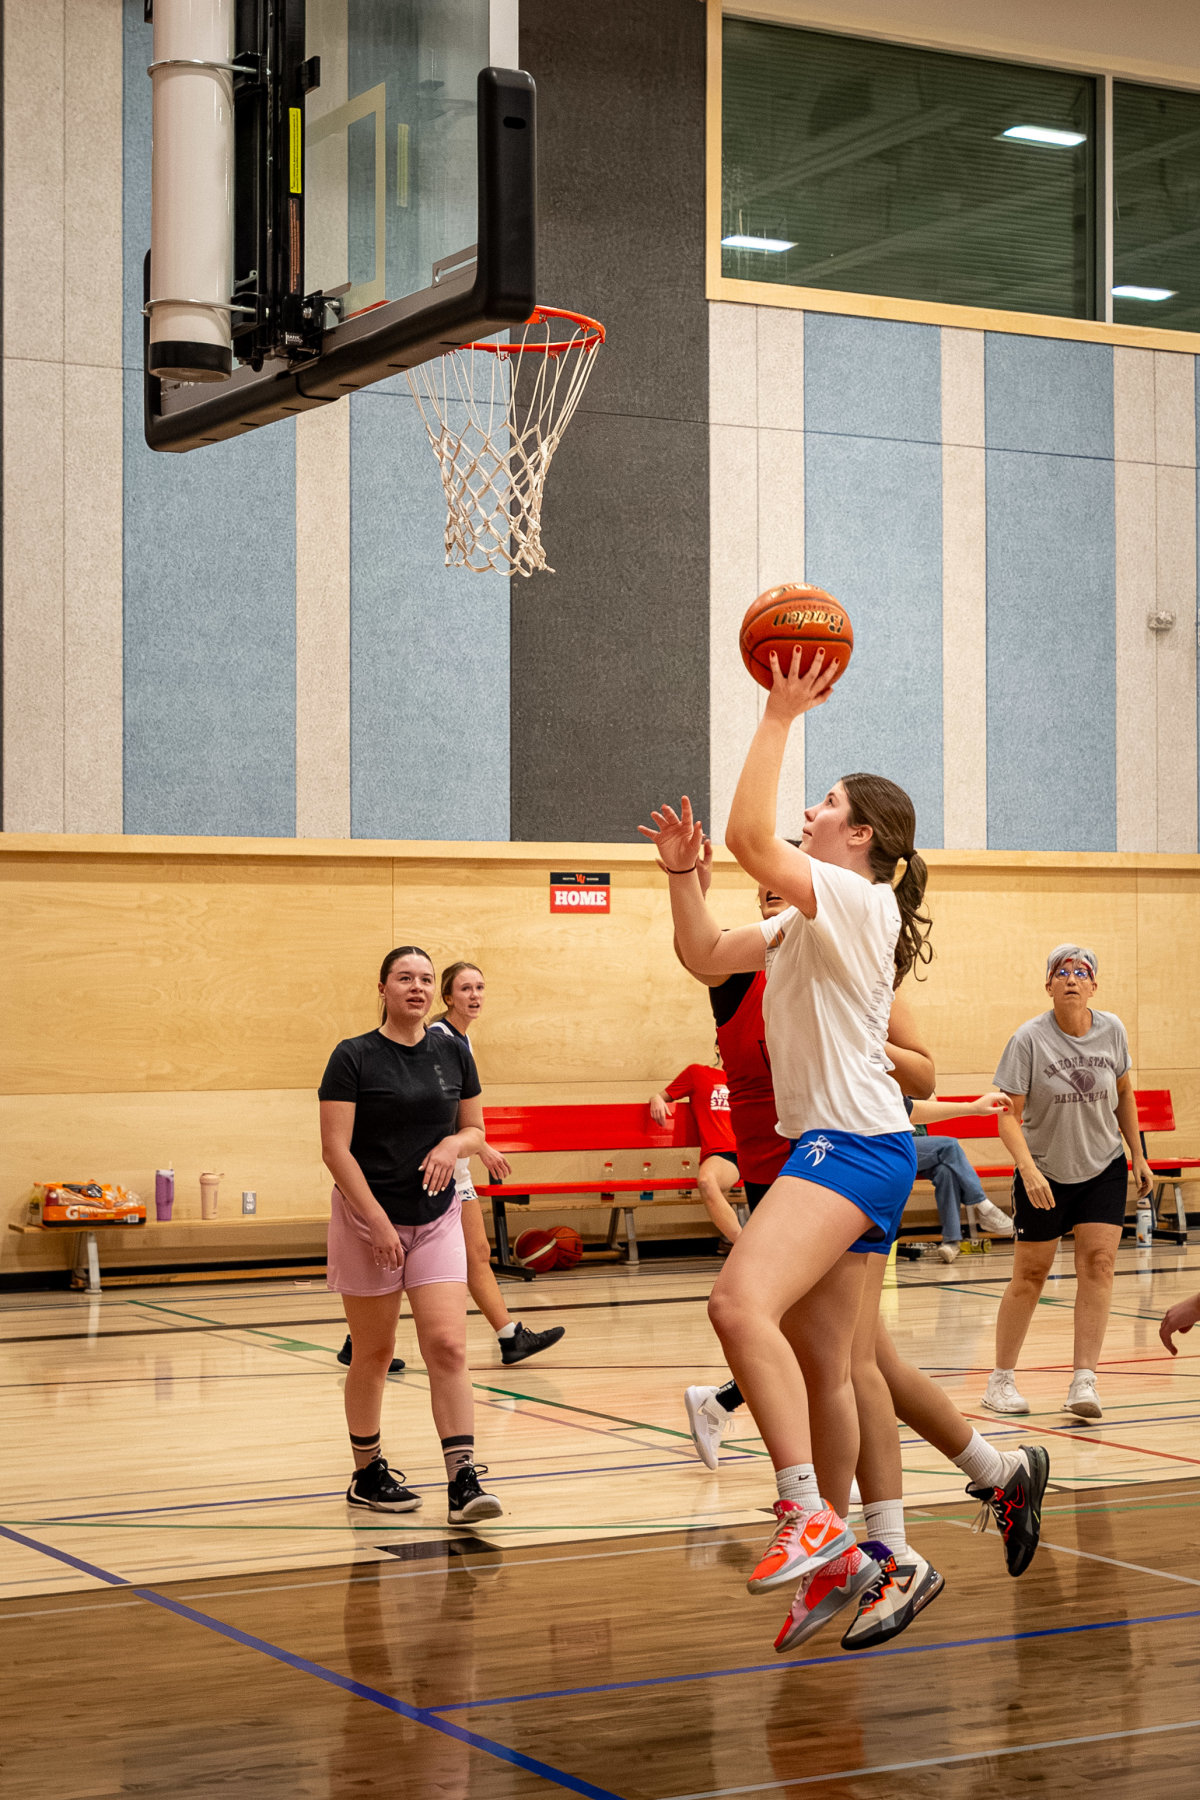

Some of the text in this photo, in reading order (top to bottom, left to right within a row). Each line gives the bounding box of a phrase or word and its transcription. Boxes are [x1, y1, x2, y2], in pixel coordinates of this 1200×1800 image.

[772, 608, 844, 634] Baden
[554, 890, 607, 906] HOME
[1043, 1055, 1084, 1079] ARZONA
